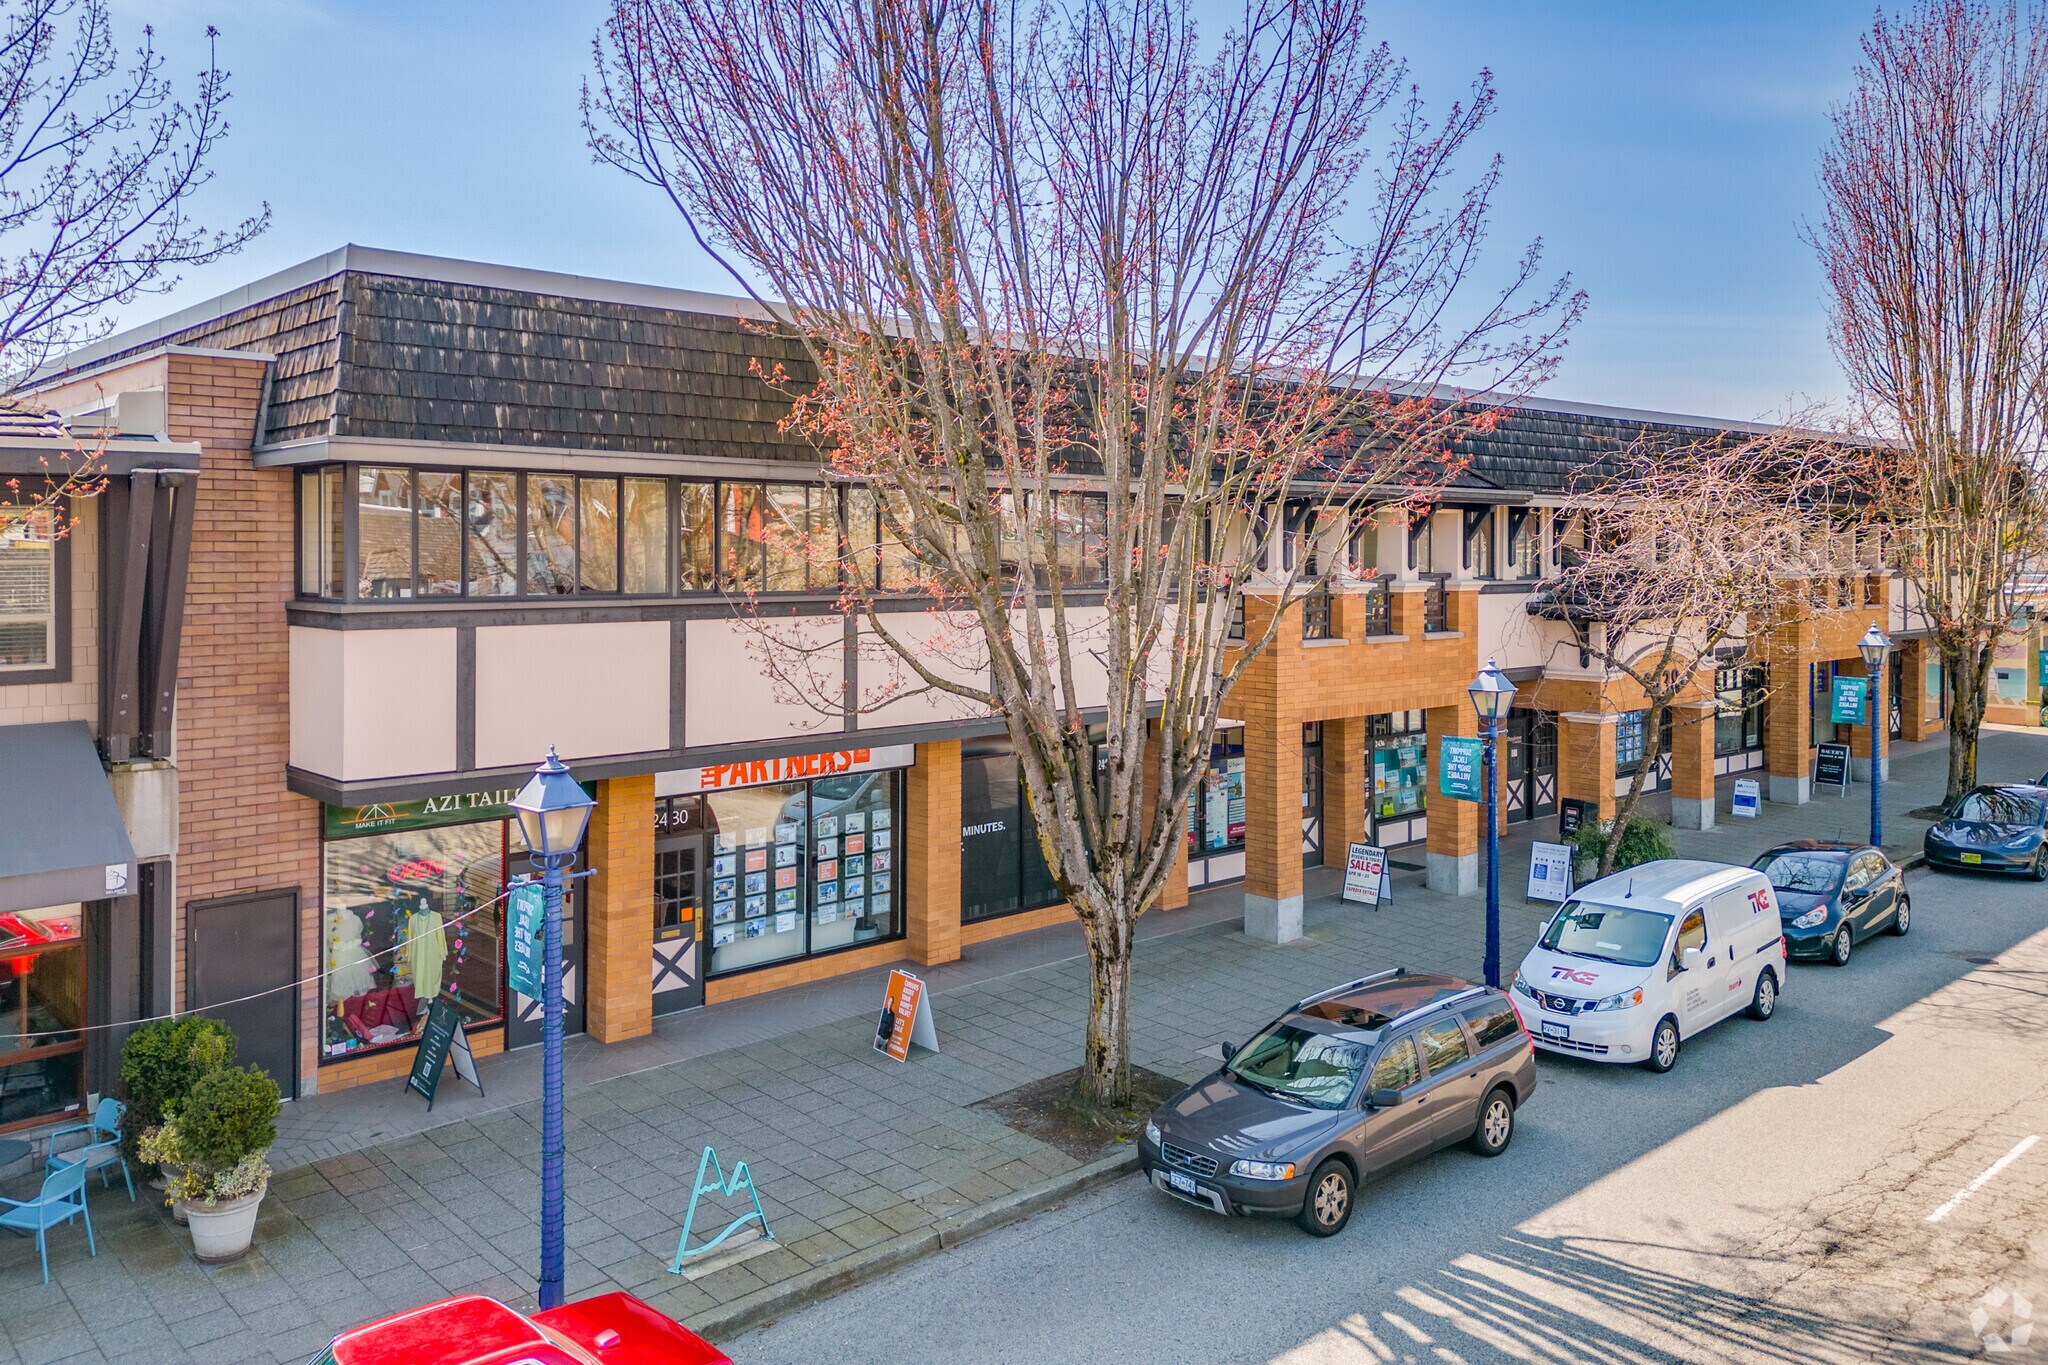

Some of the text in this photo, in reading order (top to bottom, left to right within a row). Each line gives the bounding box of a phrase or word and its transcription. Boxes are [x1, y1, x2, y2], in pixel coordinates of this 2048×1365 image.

[714, 750, 852, 788] PARTNERS
[423, 788, 520, 814] AZI TAIL
[356, 821, 376, 829] MAKE
[962, 820, 1006, 837] MINUTES.
[1352, 846, 1384, 858] LEGENDARY
[388, 858, 446, 882] OPEN
[1350, 859, 1371, 872] SALE
[1747, 888, 1770, 914] TKE
[1551, 966, 1600, 986] TKE
